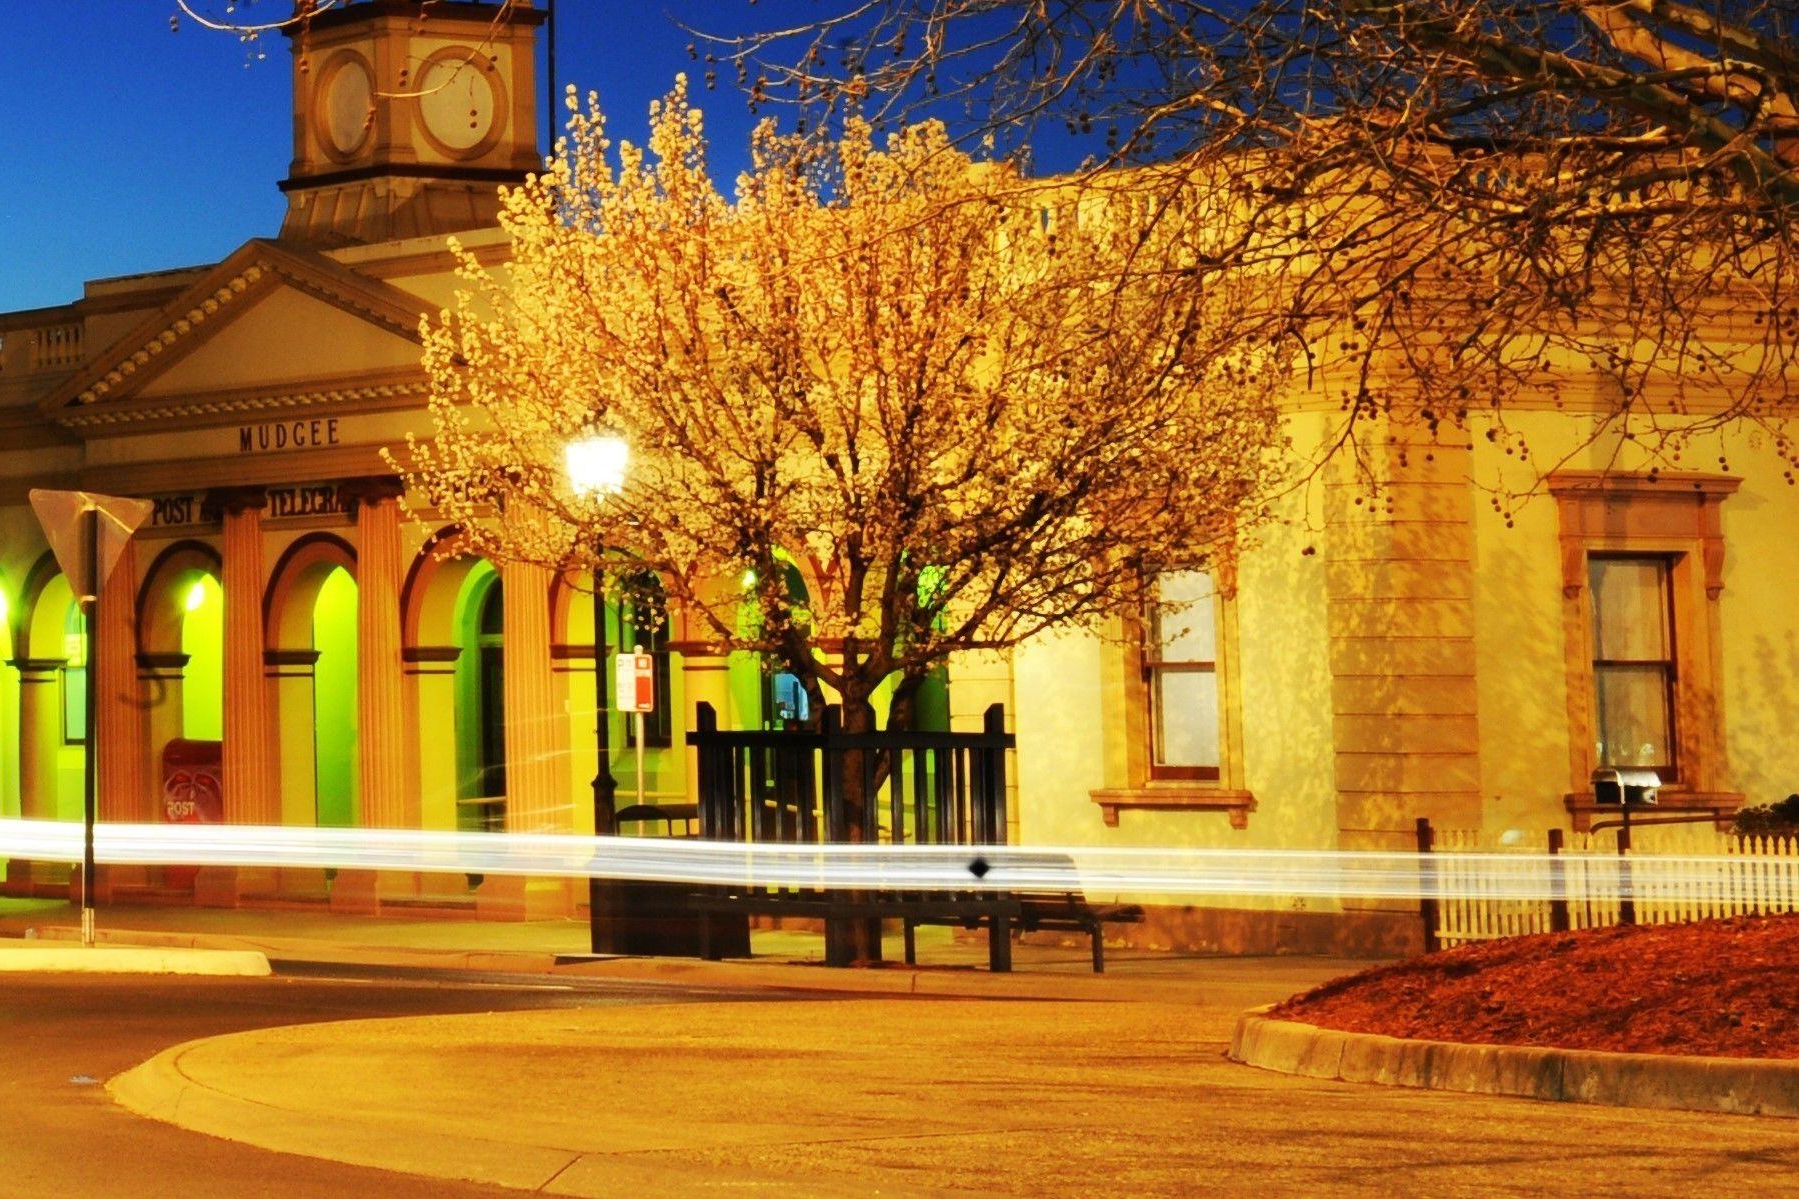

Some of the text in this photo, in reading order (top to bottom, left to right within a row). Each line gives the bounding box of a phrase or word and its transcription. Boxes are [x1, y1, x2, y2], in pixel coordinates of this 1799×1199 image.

[239, 419, 339, 452] MUDGEE
[151, 496, 194, 525] POST
[167, 801, 195, 816] POST
